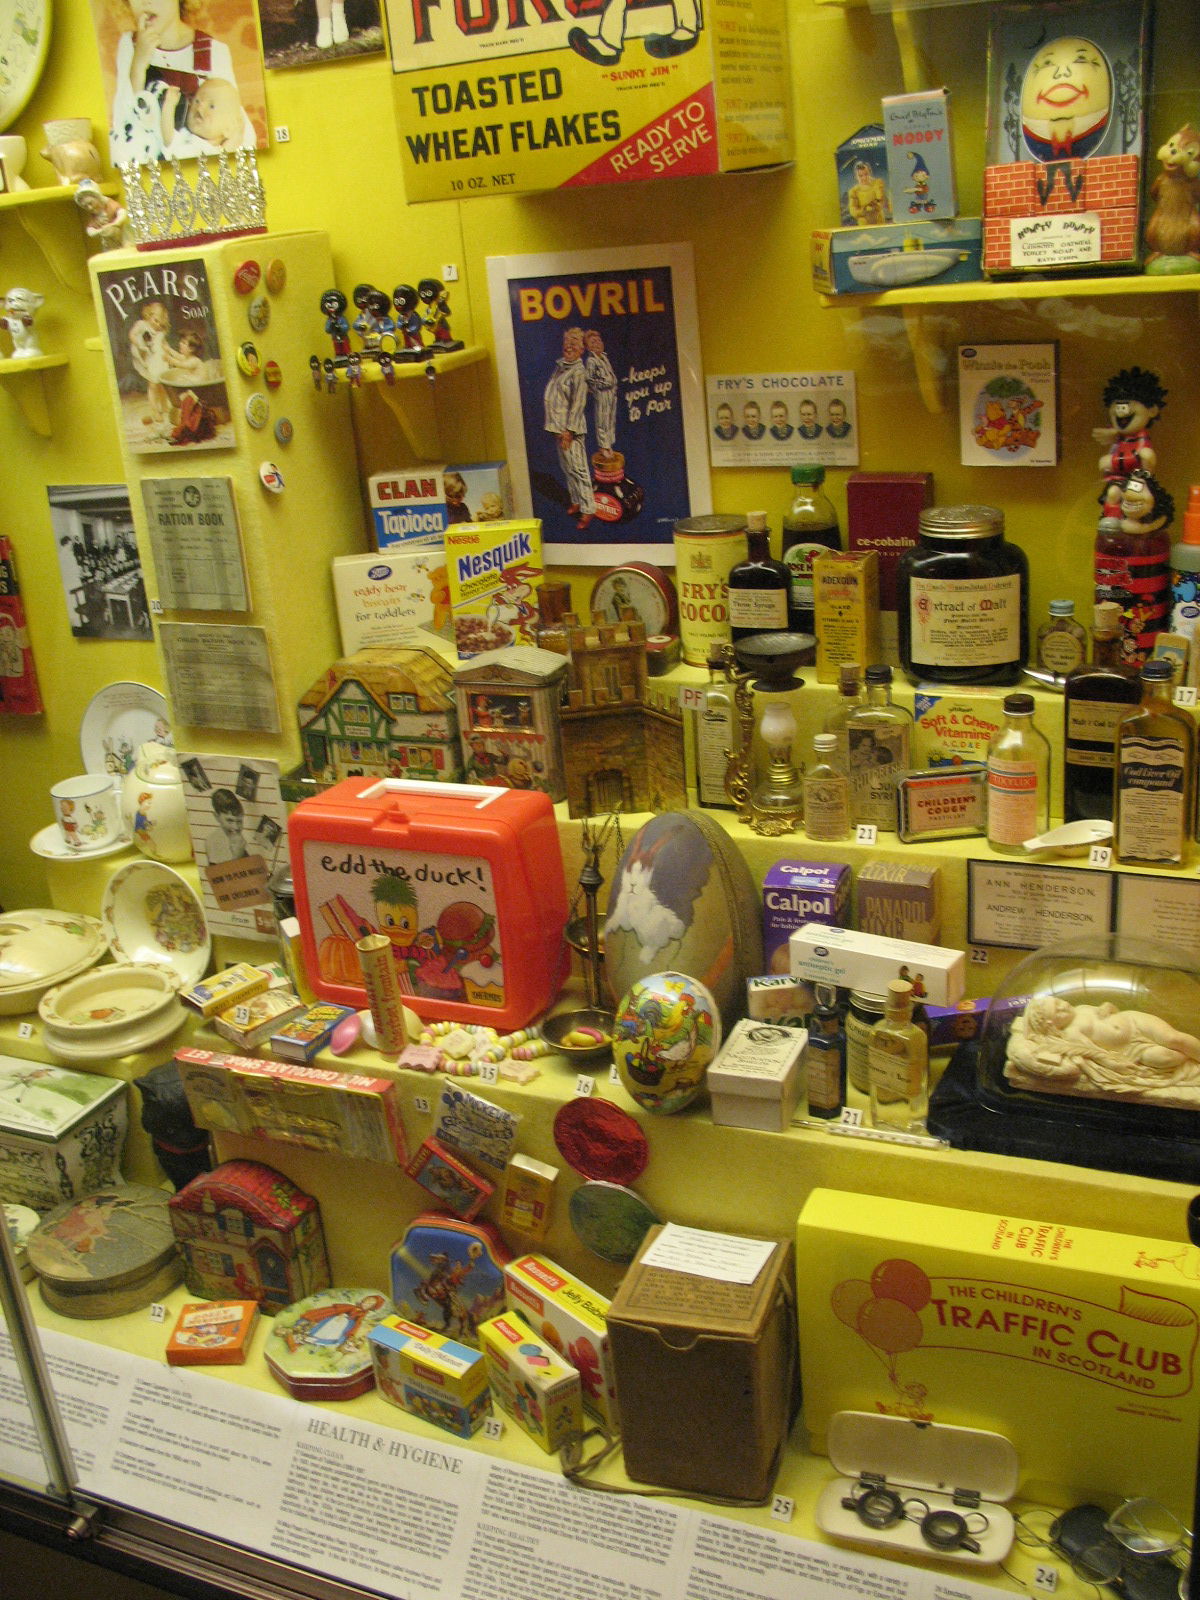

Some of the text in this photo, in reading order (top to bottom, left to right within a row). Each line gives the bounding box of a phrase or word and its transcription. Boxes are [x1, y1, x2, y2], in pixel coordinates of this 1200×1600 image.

[411, 66, 563, 117] TOASTED
[277, 129, 288, 139] 18
[405, 109, 622, 165] WHEAT FLAKES
[608, 120, 678, 175] READY
[673, 101, 706, 131] TO
[893, 129, 943, 147] NODDY
[649, 123, 712, 174] SERVE
[451, 180, 464, 192] 10
[492, 173, 517, 187] NET
[1018, 220, 1053, 240] HUMPTY
[1062, 221, 1096, 234] DUMPTY
[448, 266, 453, 276] 7
[519, 279, 666, 322] BOVRIL
[717, 376, 844, 390] FRY'S CHOCOLATE
[625, 381, 673, 407] you up
[629, 405, 642, 423] to
[377, 478, 438, 501] CLAN
[158, 512, 225, 527] RATION BOOK
[378, 509, 444, 538] Tapioca
[857, 537, 916, 547] ce-cobalin
[458, 532, 532, 583] Nesquik
[460, 573, 498, 593] Chocolate
[682, 576, 729, 600] FRY'S
[968, 602, 976, 611] of
[980, 598, 1007, 611] Malt
[355, 607, 416, 622] for toddlers
[680, 603, 729, 623] COCO
[1178, 690, 1194, 703] 17
[920, 714, 947, 729] Soft
[951, 714, 959, 724] &
[935, 727, 991, 740] Vitamins
[1124, 767, 1141, 777] Cod
[917, 796, 977, 808] CHILDREN'S
[928, 805, 967, 815] COUGH
[858, 828, 873, 840] 21
[1092, 850, 1108, 862] 19
[322, 854, 487, 892] edd the duck!
[780, 865, 830, 876] Calpol
[986, 879, 1011, 889] ANN
[765, 892, 831, 917] Calpol
[865, 897, 926, 923] PANADOL
[986, 904, 1025, 915] ANDREW
[972, 950, 987, 961] 22
[236, 1007, 248, 1020] 13
[184, 1047, 214, 1060] SET
[264, 1060, 339, 1081] CHOCOLATE
[482, 1066, 495, 1080] 15
[576, 1079, 589, 1094] 16
[415, 1098, 428, 1110] 13
[843, 1111, 858, 1122] 21
[1015, 1226, 1034, 1249] CLUB
[1030, 1225, 1054, 1258] TRAFFIC
[563, 1289, 581, 1304] Jelly
[947, 1285, 1083, 1322] THE CHILDREN'S
[152, 1306, 163, 1317] 12
[931, 1299, 1184, 1377] TRAFFIC CLUB
[1032, 1345, 1156, 1392] IN SCOTLAND
[485, 1422, 499, 1436] 15
[307, 1418, 463, 1474] HEALTH & HYGIENE
[773, 1499, 790, 1513] 25
[1037, 1568, 1055, 1585] 24
